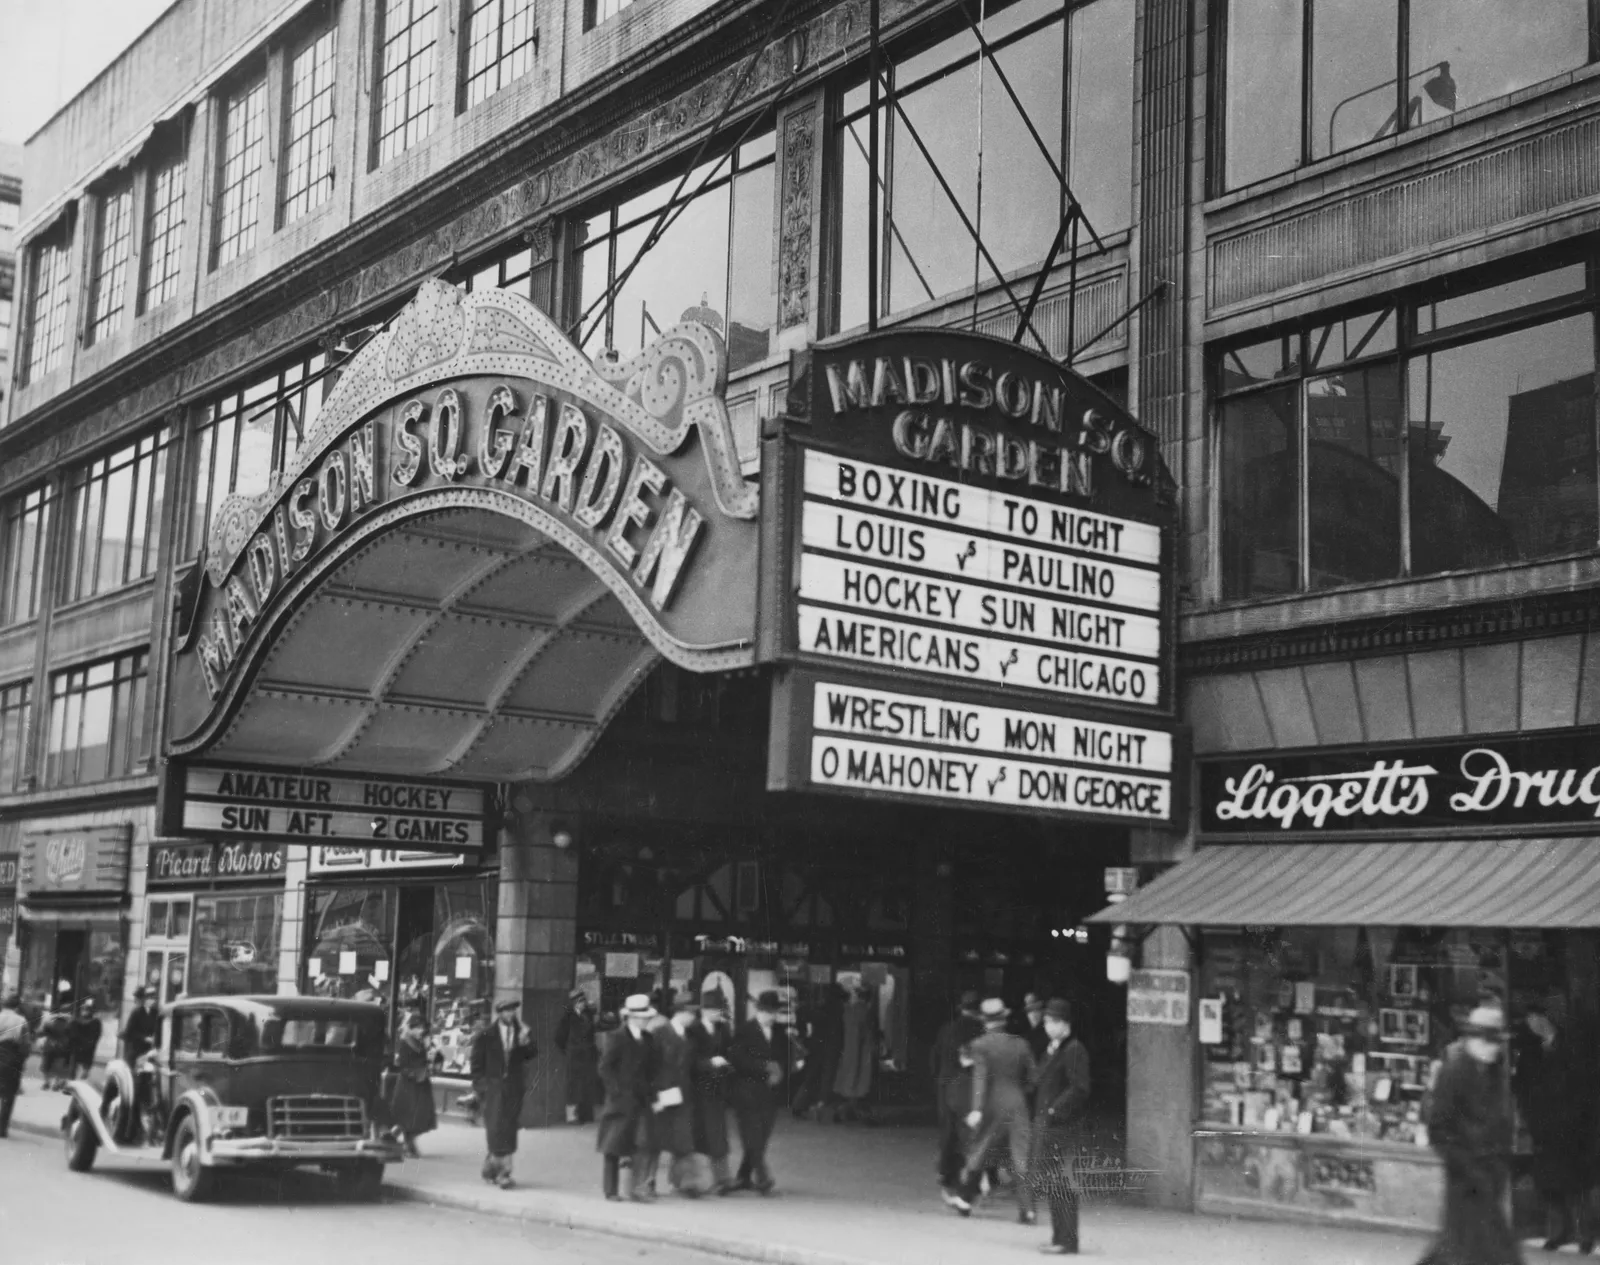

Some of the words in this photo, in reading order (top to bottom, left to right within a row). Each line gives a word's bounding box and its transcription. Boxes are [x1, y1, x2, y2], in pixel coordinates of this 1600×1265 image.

[825, 356, 1066, 432] MADISON
[892, 410, 1093, 496] GARDEN
[197, 418, 384, 700] MADISON
[391, 387, 468, 488] SQ.
[477, 383, 704, 612] GARDEN
[838, 463, 960, 519] BOXING
[1004, 500, 1039, 535] TO
[1050, 509, 1125, 553] NIGHT
[836, 514, 926, 562] LOUIS
[1002, 550, 1114, 598] PAULINO
[843, 568, 961, 618] HOCKEY
[980, 595, 1035, 632] SUN
[1052, 608, 1126, 647] NIGHT
[813, 617, 981, 673] AMERICANS
[1037, 655, 1145, 698] CHICAGO
[827, 692, 980, 742] WRESTLING
[1004, 717, 1056, 753] MON
[1074, 726, 1147, 764] NIGHT
[217, 773, 333, 802] AMATEUR
[363, 783, 453, 810] HOCKEY
[221, 806, 270, 832] SUN
[286, 812, 337, 837] AFT.
[372, 816, 388, 838] 2
[394, 819, 470, 843] GAMES
[1018, 769, 1067, 802] DON
[1074, 779, 1163, 815] GEORGE
[156, 850, 211, 877] Picard
[218, 844, 282, 873] Motors
